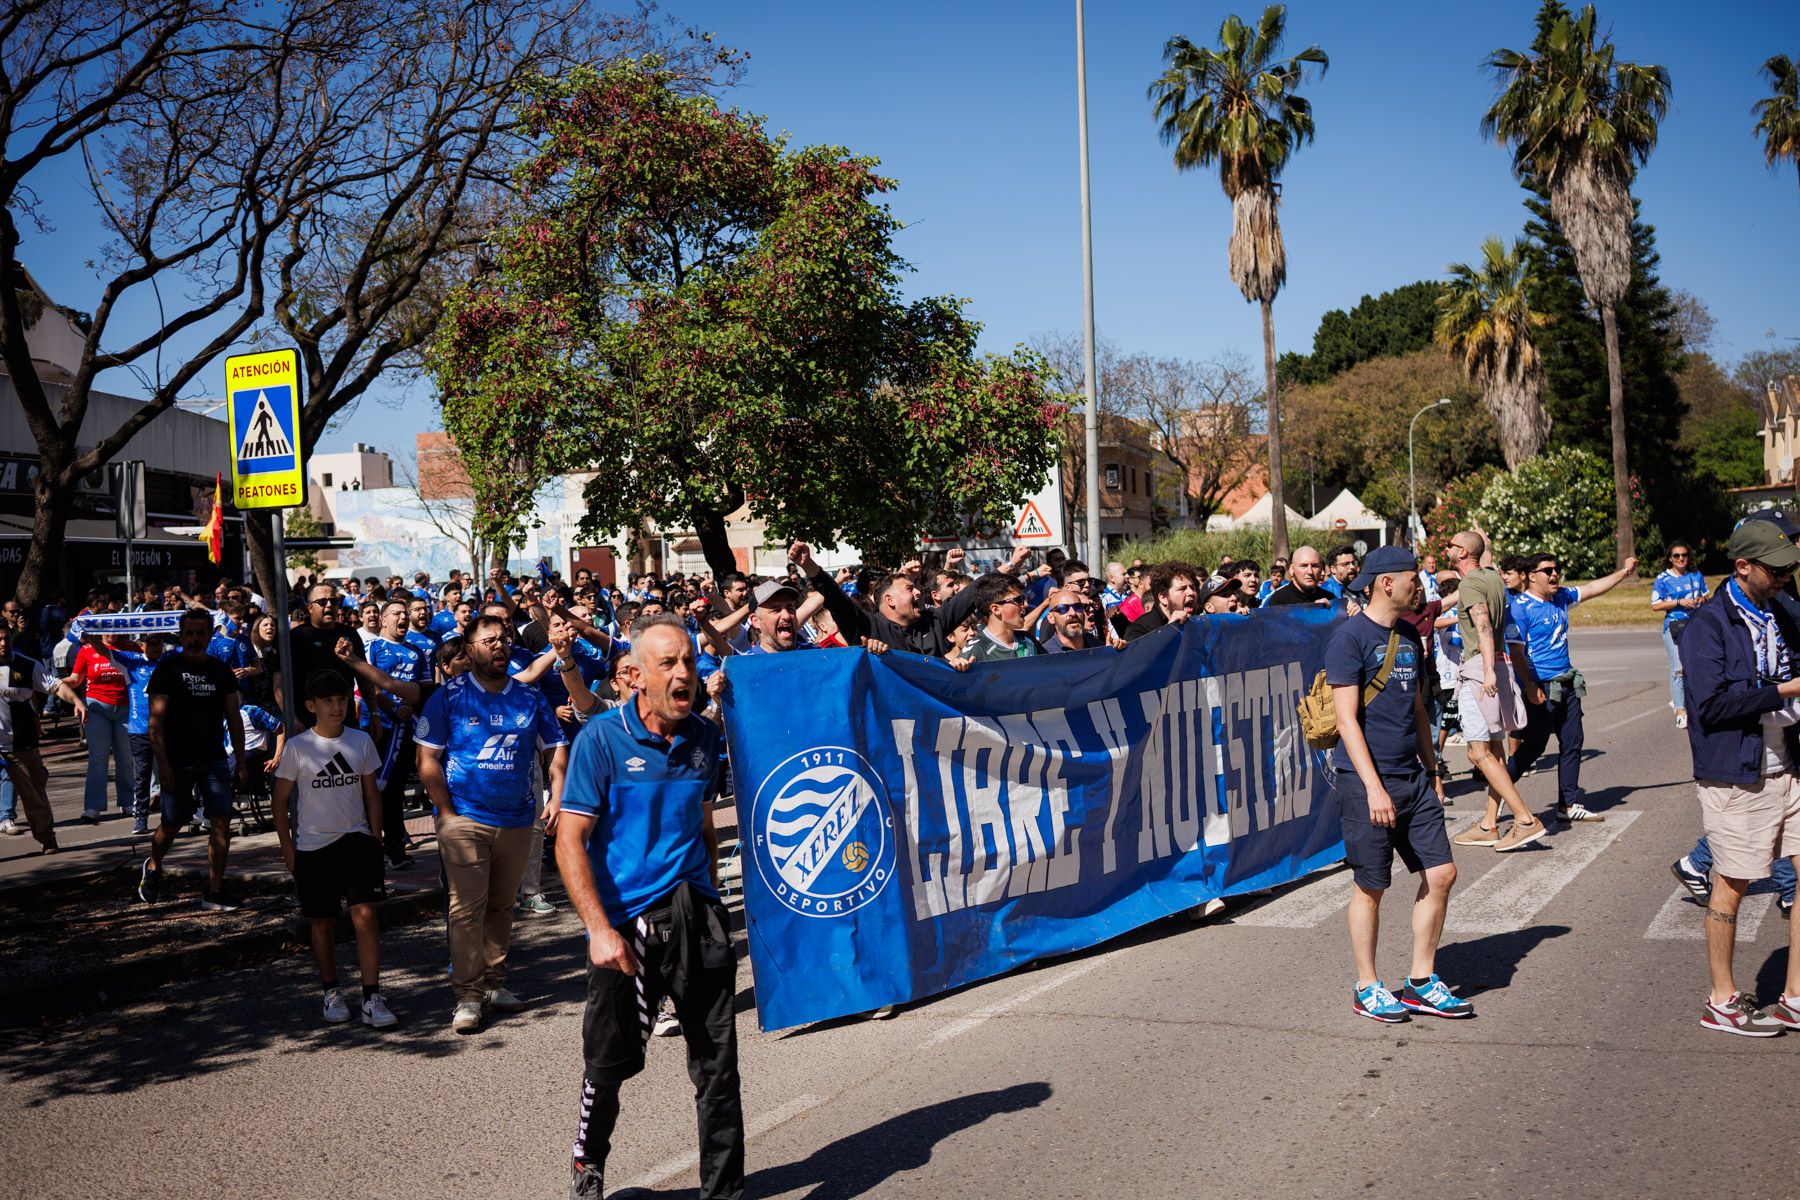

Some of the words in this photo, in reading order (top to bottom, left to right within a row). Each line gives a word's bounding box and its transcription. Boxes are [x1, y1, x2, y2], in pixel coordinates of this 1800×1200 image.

[233, 360, 290, 379] ATENCIÓN
[239, 483, 297, 498] PEATONES
[112, 550, 121, 566] EL
[126, 548, 161, 566] ODEGÓN
[181, 672, 206, 684] Pepe
[187, 681, 216, 691] Jeans
[494, 748, 517, 760] Air
[801, 752, 843, 768] 1911
[478, 762, 515, 770] oneair.es
[312, 773, 360, 788] adidas
[891, 707, 1084, 922] LIBRE
[1088, 698, 1130, 874] Y
[1138, 662, 1312, 864] NUESTRO
[756, 834, 764, 847] F
[793, 785, 862, 884] XEREZ
[777, 868, 886, 913] DEPORTIVO
